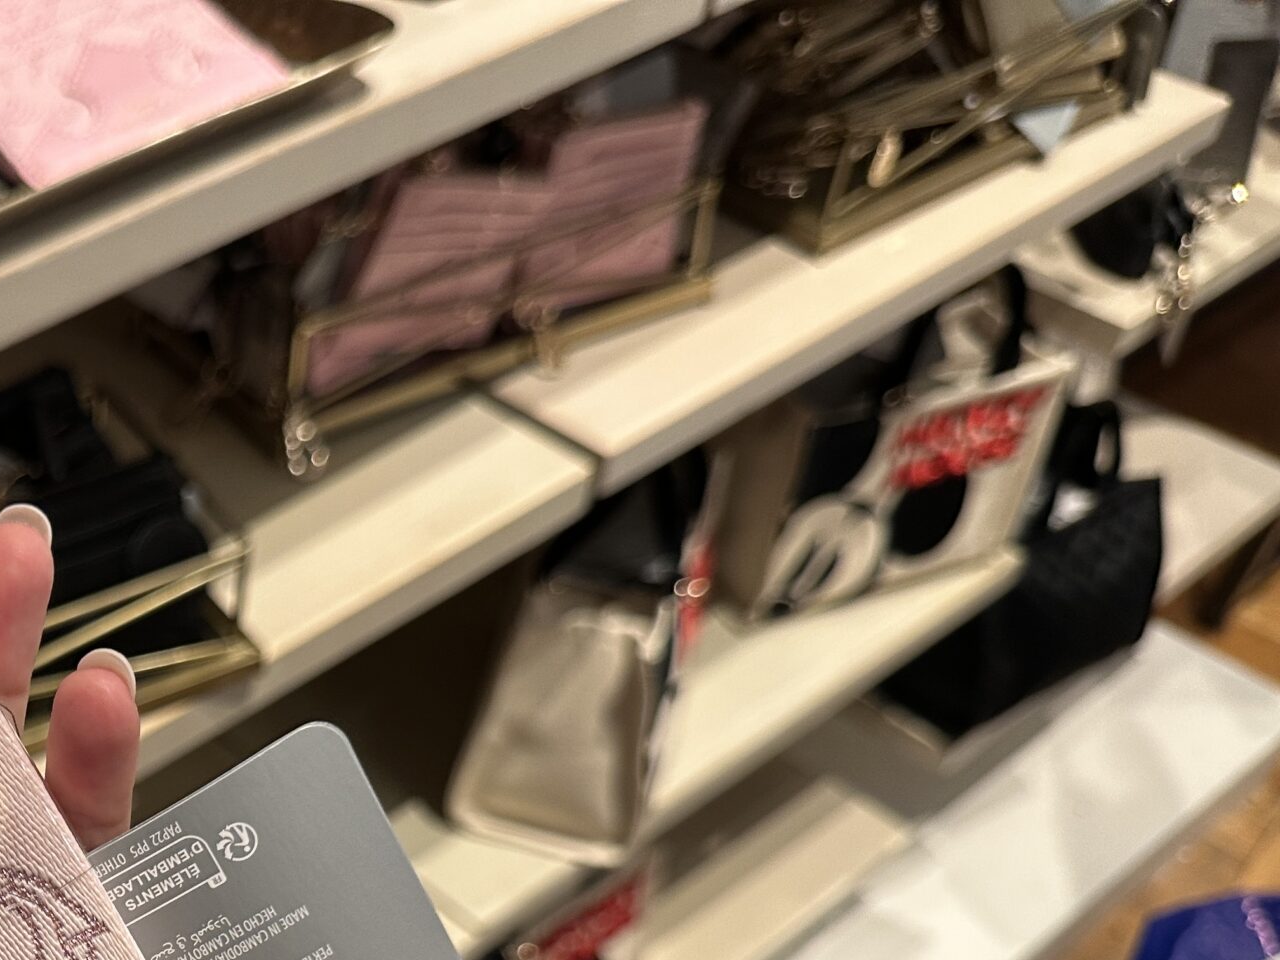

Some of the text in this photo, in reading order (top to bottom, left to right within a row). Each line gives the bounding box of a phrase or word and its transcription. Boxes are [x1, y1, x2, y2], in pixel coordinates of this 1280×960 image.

[148, 820, 182, 846] PAP22
[129, 839, 150, 858] PP5
[124, 862, 200, 911] ÉLÉMENTS
[242, 905, 277, 931] HECHO
[267, 921, 281, 936] IN
[278, 904, 309, 929] MADE
[228, 923, 244, 940] EN
